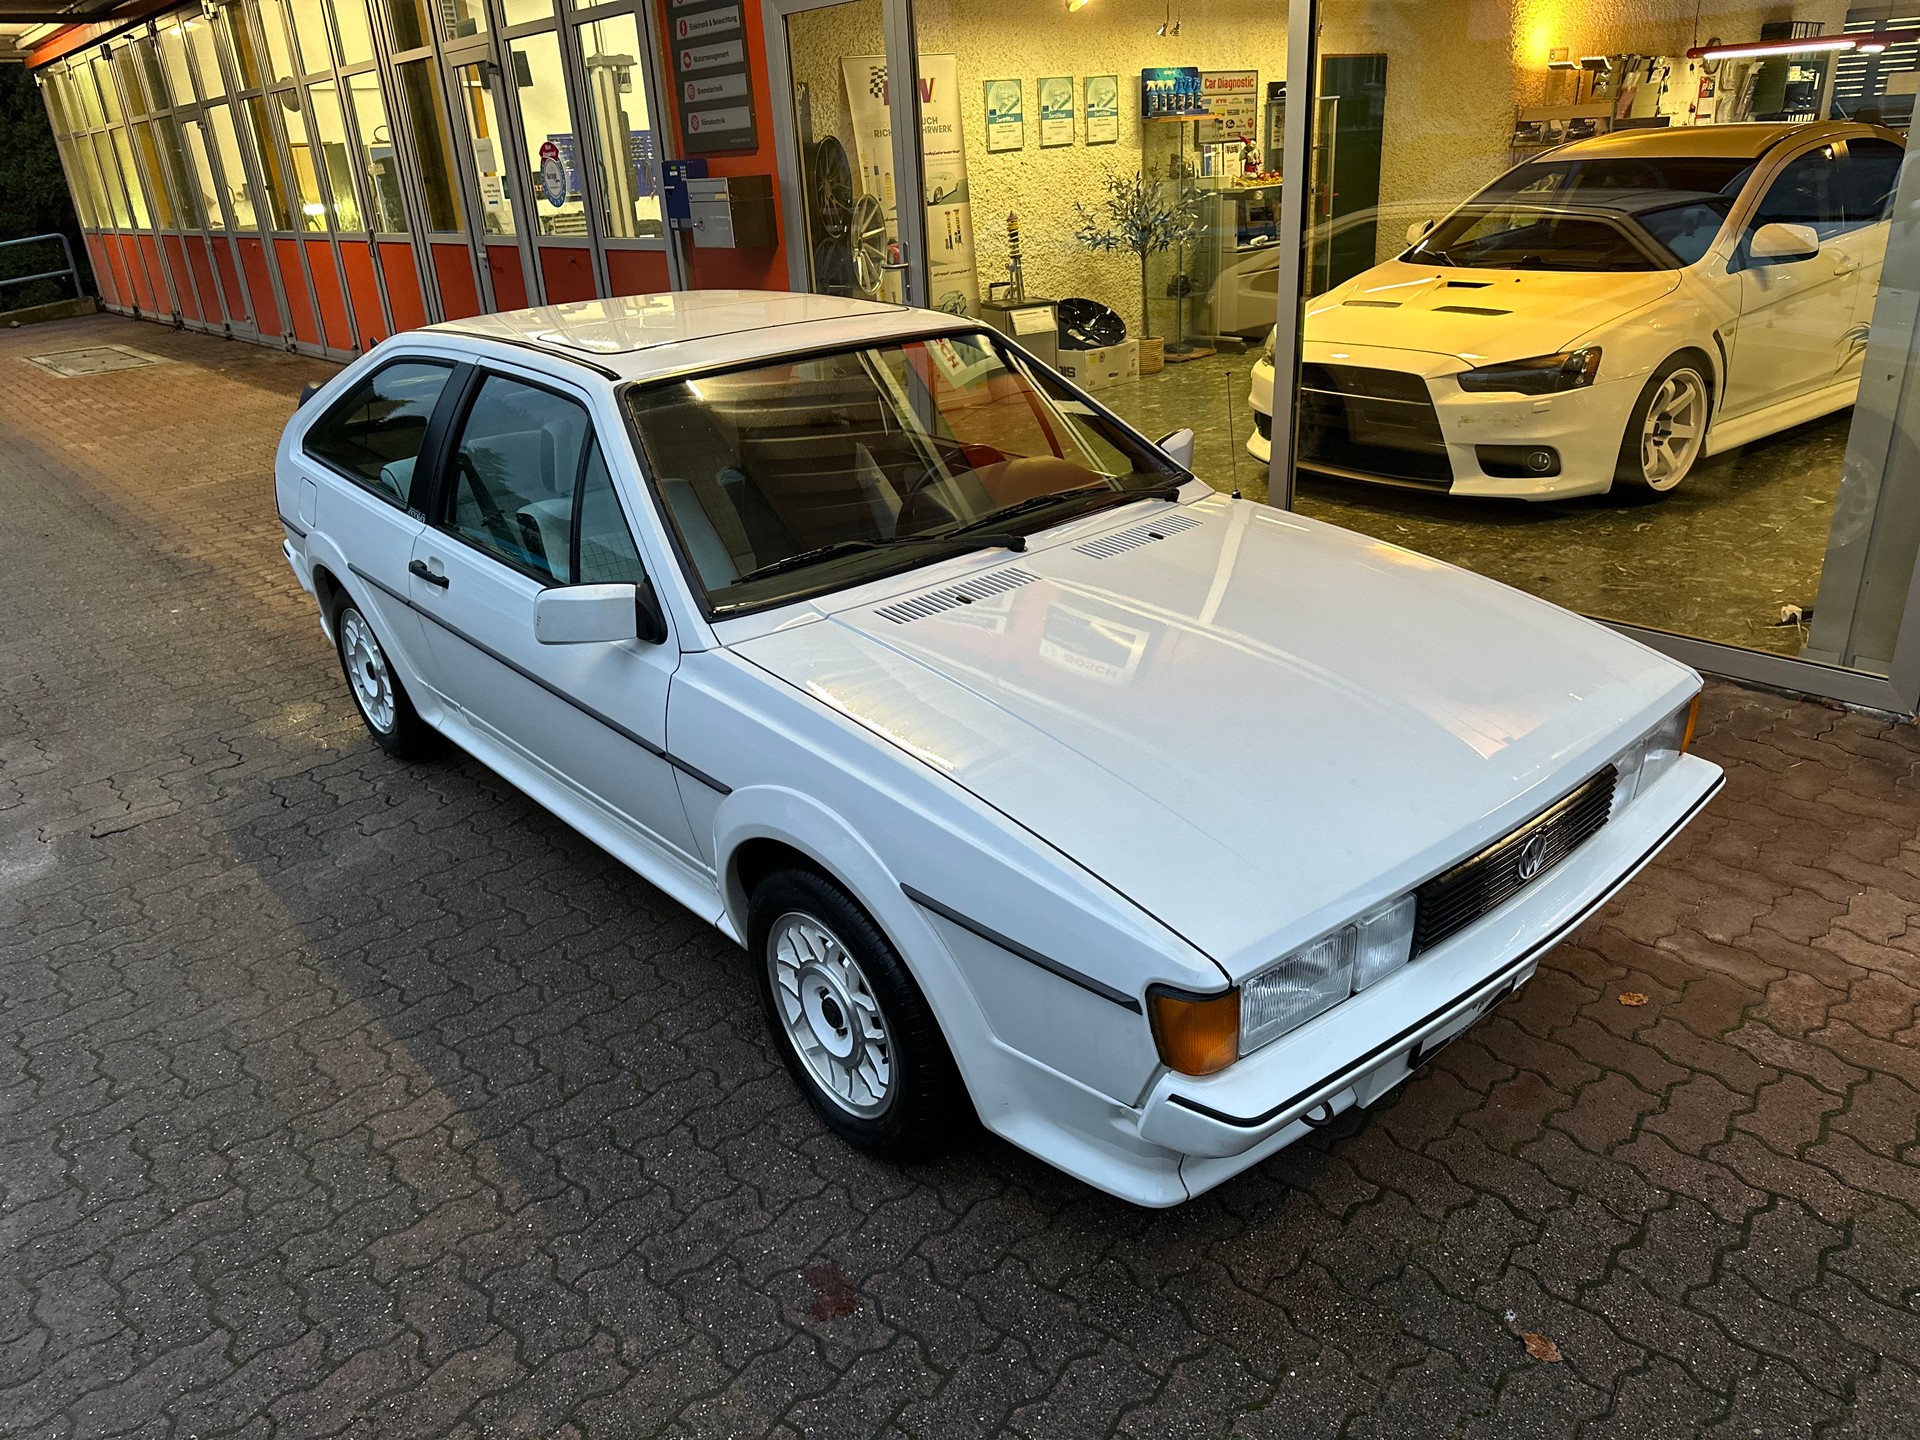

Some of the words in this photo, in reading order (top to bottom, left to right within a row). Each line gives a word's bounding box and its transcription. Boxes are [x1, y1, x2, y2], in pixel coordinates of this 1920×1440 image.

[713, 15, 738, 26] Beleuchtung
[1204, 78, 1217, 90] Car
[1217, 76, 1254, 91] Diagnostic
[874, 128, 892, 138] RICH
